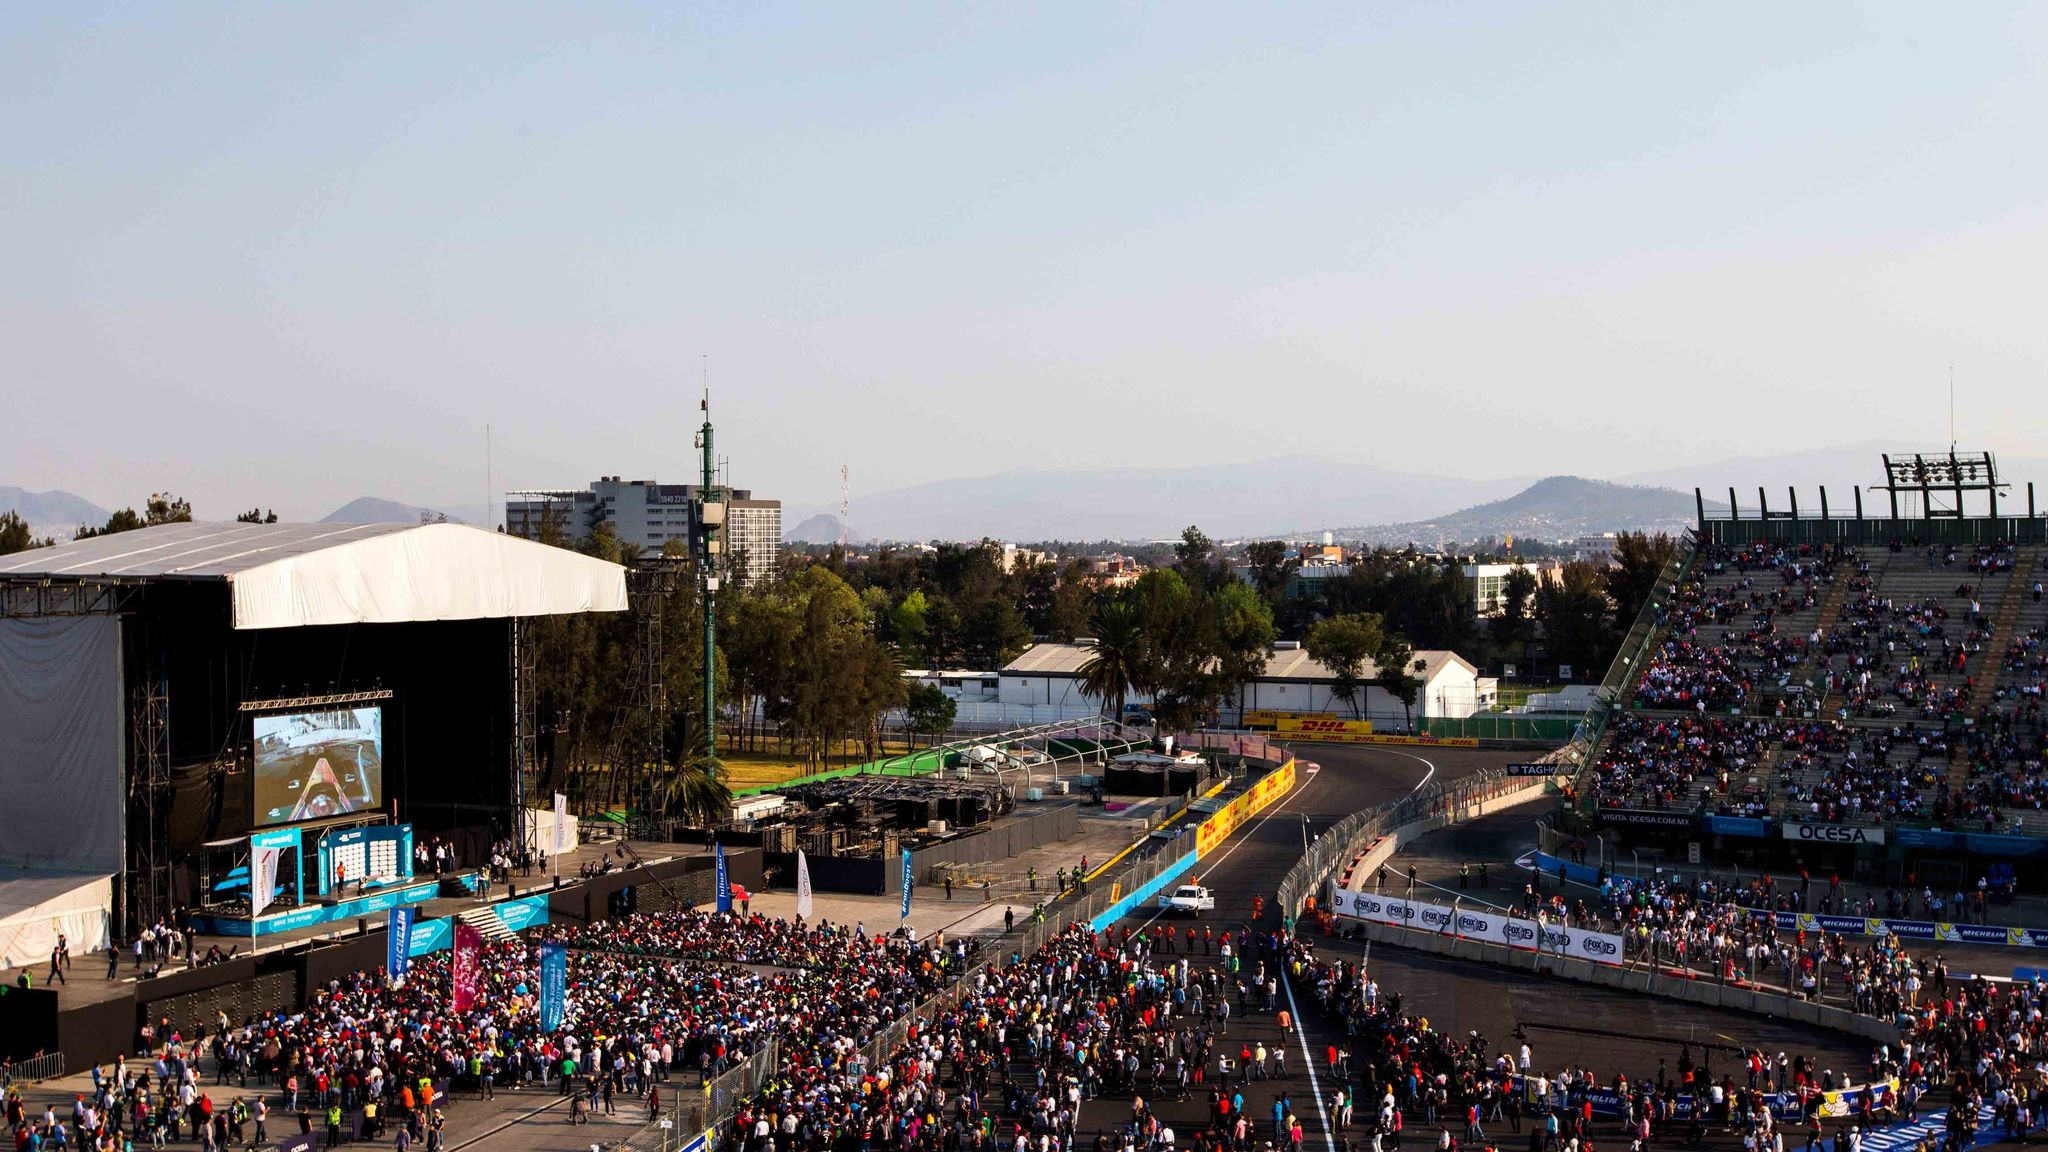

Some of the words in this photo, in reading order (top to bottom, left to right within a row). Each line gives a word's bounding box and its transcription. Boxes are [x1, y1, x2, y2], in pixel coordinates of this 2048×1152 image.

[1301, 720, 1348, 732] DHL
[1602, 813, 1627, 821] VISITA
[1629, 815, 1690, 826] OCESA.COM.MX
[1800, 825, 1866, 843] OCESA
[902, 864, 911, 912] #FanBoost
[1390, 905, 1403, 914] FOX
[1425, 911, 1438, 921] FOX
[1462, 917, 1475, 926] FOX
[1822, 919, 1864, 928] MICHELIN
[1508, 925, 1520, 934] FOX
[1891, 924, 1934, 933] MICHELIN
[1962, 929, 2007, 938] MICHELIN
[396, 910, 406, 971] MICHELIN
[1587, 939, 1602, 949] FOX
